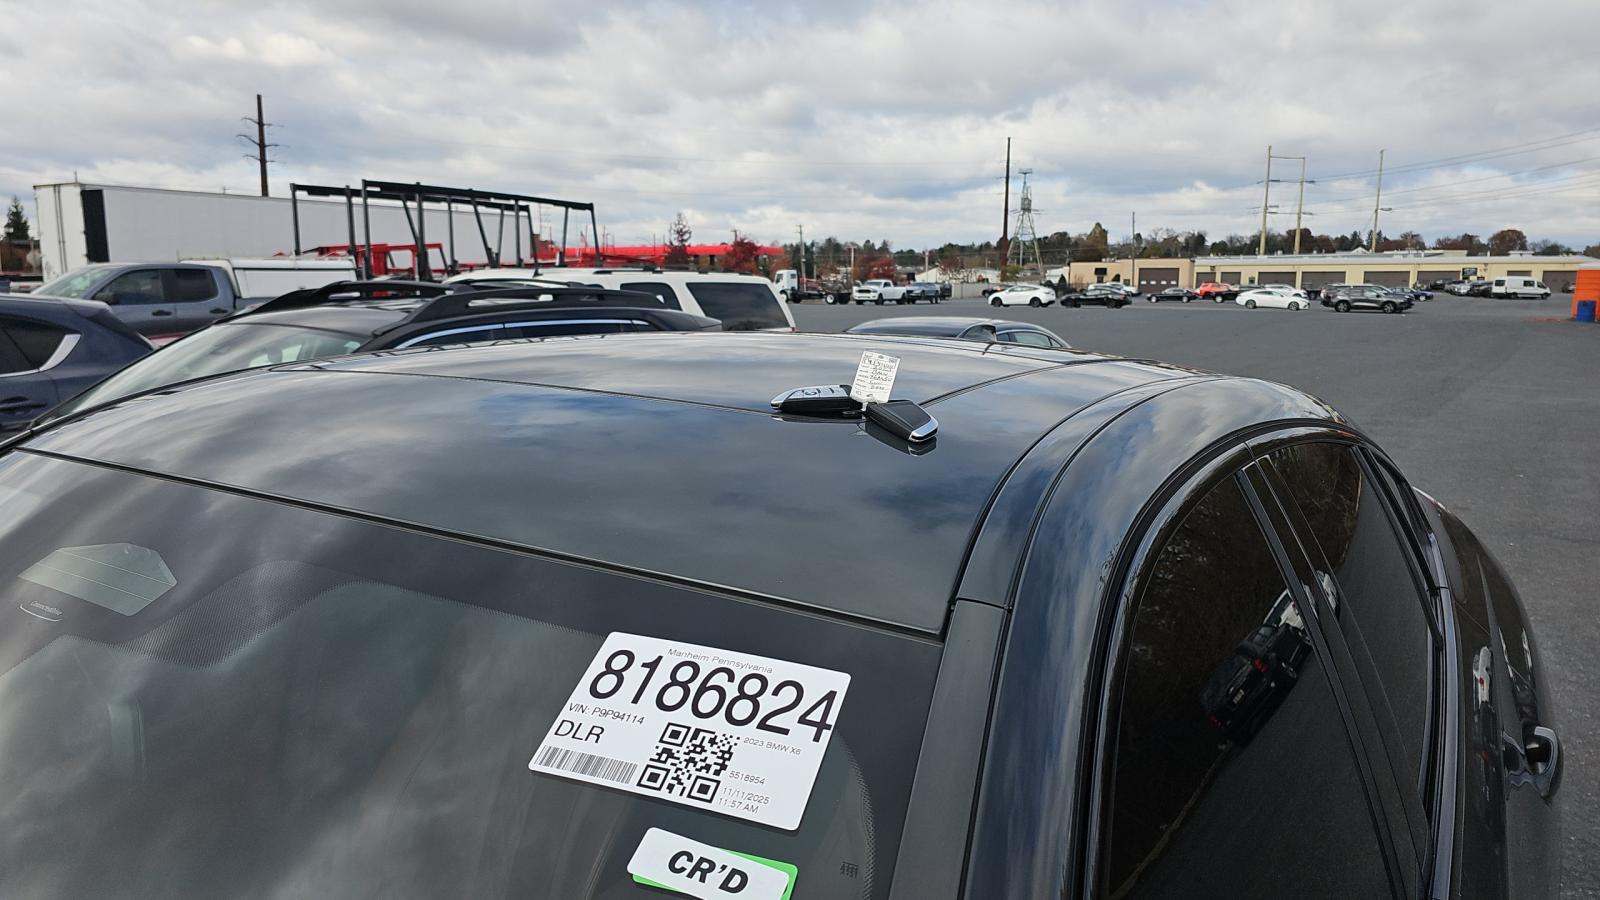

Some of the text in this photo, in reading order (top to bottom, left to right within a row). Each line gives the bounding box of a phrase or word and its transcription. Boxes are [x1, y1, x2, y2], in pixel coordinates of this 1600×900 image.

[667, 648, 773, 674] Manheim Pennsylvania
[589, 649, 838, 743] 8186824
[568, 702, 645, 724] VIN: P9P94114
[554, 719, 605, 744] DLR
[743, 737, 802, 756] 2023 BMW X6
[728, 770, 766, 785] 5518954
[719, 797, 759, 814] 11:57 AM
[723, 787, 770, 805] 11/11/2025
[668, 850, 749, 894] CR'D
